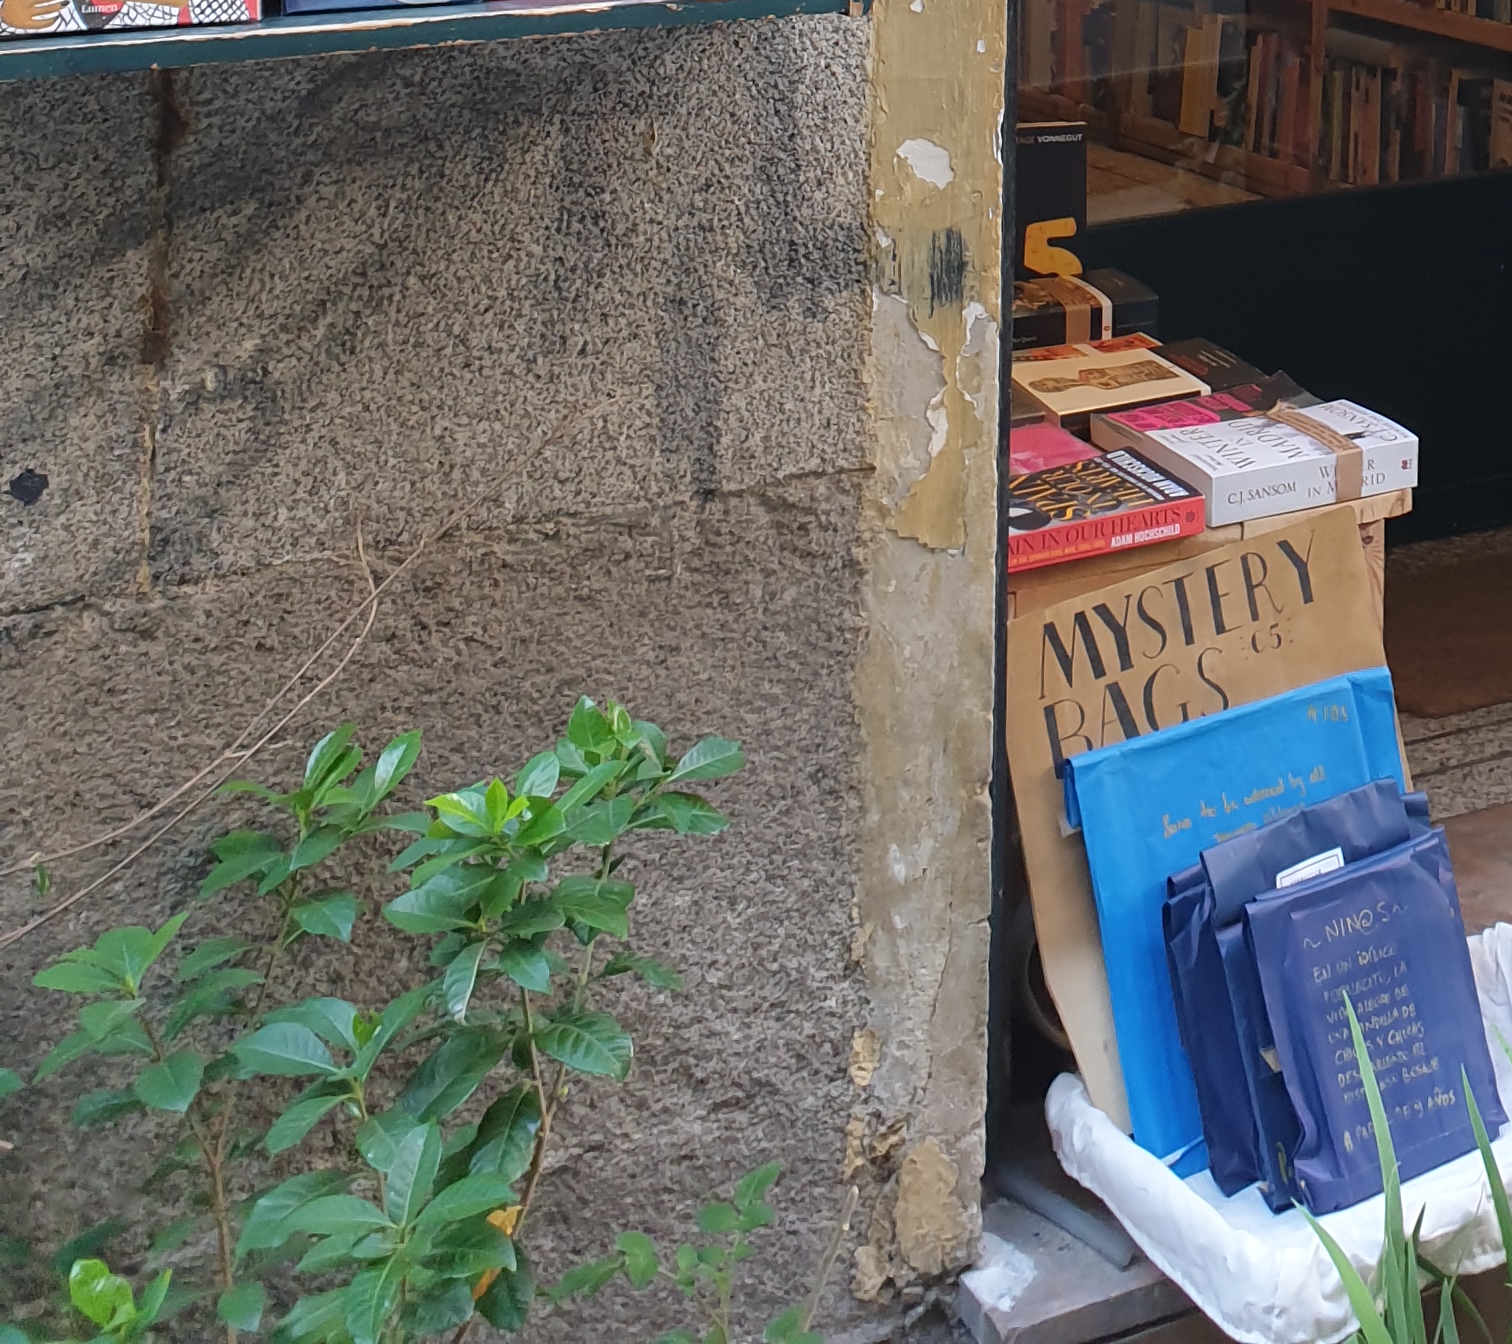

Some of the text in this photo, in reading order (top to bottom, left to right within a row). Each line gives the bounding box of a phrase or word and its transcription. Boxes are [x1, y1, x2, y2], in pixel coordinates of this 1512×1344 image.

[1037, 133, 1083, 143] VONNEGUT
[1024, 216, 1084, 276] 5
[1179, 424, 1257, 470] WINTER
[1227, 481, 1297, 506] C.J. SANSOM
[1307, 485, 1323, 499] IN
[1041, 506, 1183, 550] IN OUR HEARTS
[1110, 533, 1134, 549] ADAM
[1037, 529, 1318, 700] MYSTERY
[1042, 646, 1230, 780] BAGS
